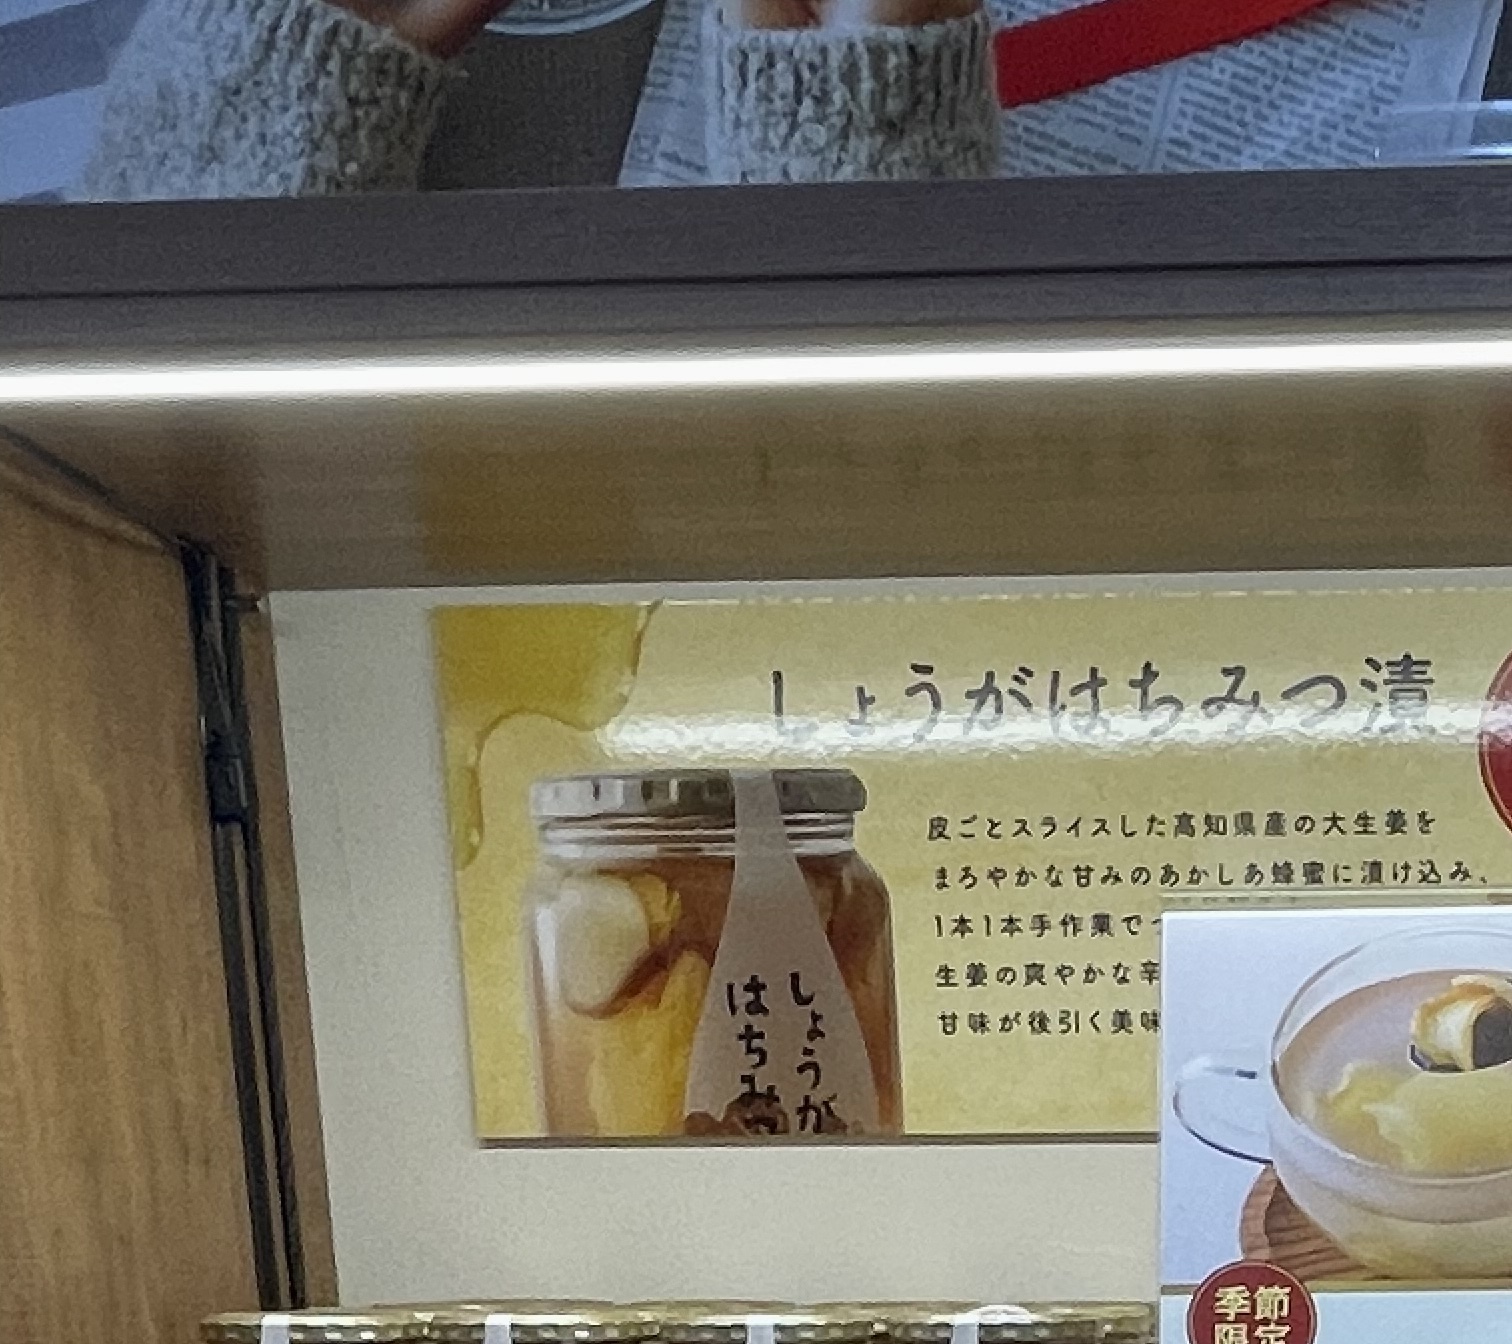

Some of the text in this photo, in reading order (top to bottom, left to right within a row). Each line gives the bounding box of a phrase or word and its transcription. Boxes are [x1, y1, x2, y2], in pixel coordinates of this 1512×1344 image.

[771, 652, 1435, 742] しょうがはちみつ漬
[927, 810, 1437, 842] 皮ごとスライスした高知県産の大生姜を
[1213, 1286, 1292, 1322] 季節
